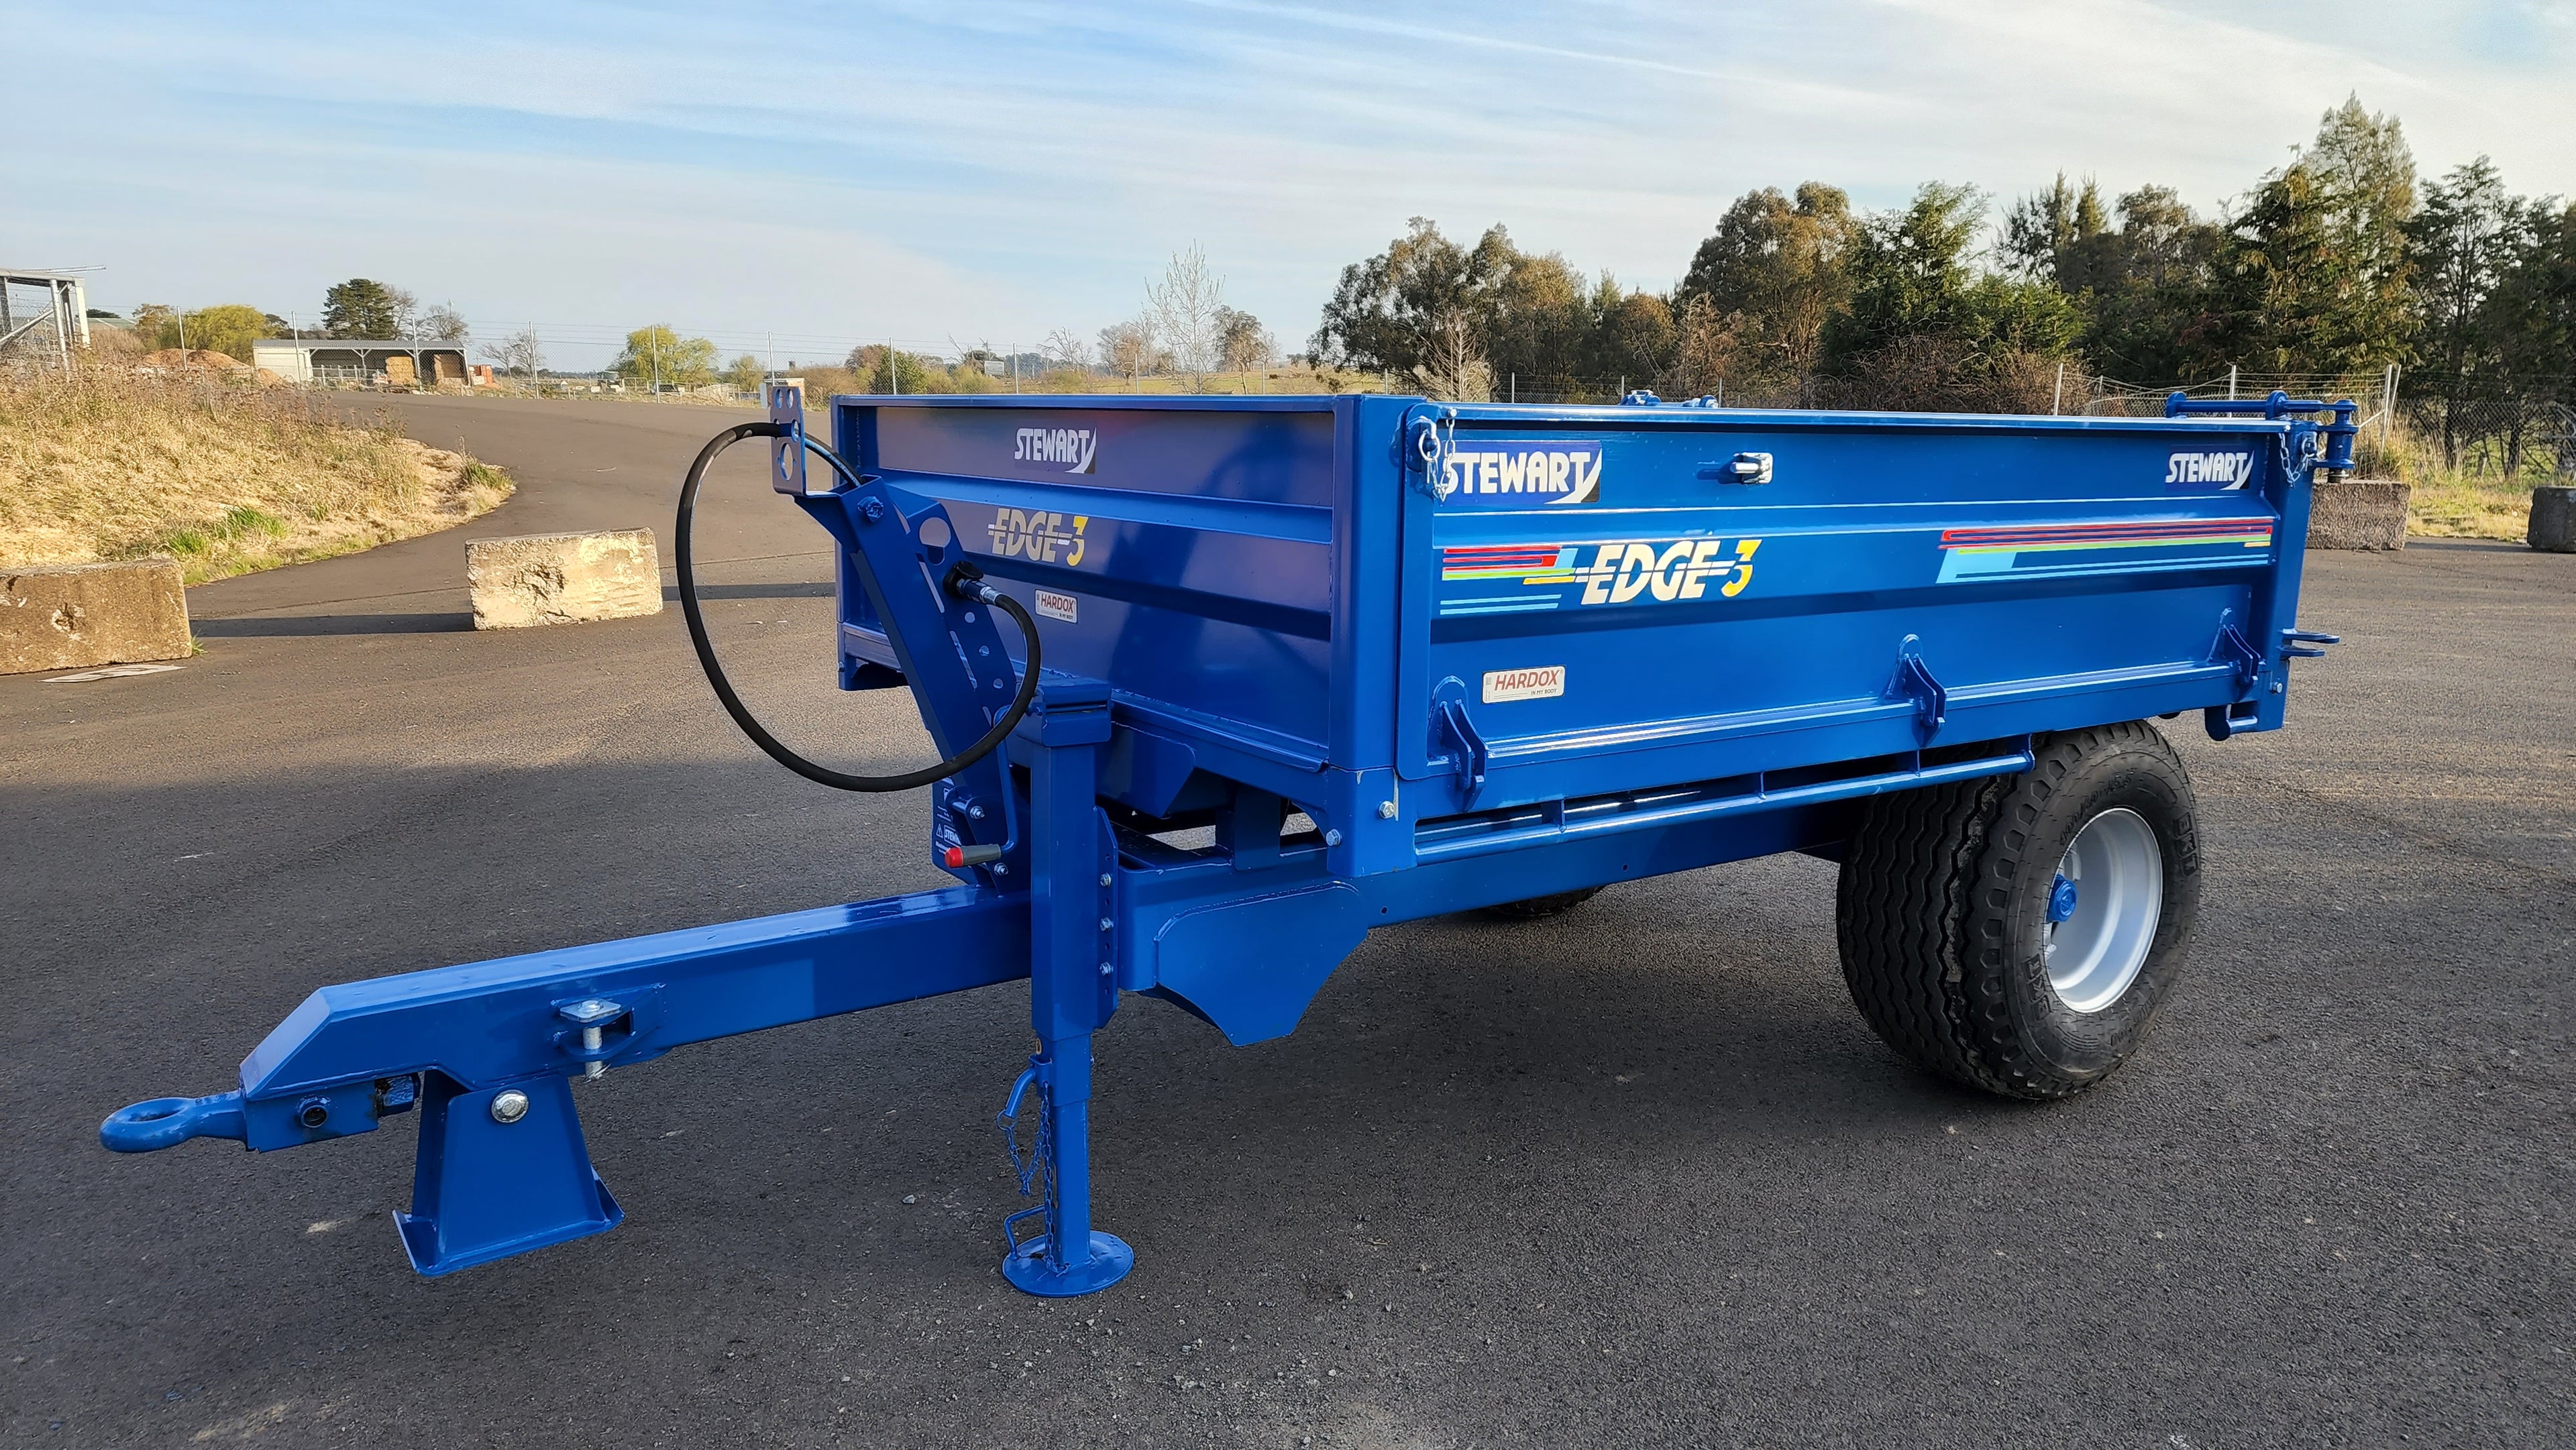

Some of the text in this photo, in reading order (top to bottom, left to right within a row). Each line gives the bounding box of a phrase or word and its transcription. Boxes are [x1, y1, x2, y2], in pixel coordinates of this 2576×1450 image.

[1014, 427, 1097, 473] STEWART
[2165, 450, 2255, 490] STEWART
[1041, 594, 1074, 613] HARDOX
[1494, 669, 1560, 691] HARDOX
